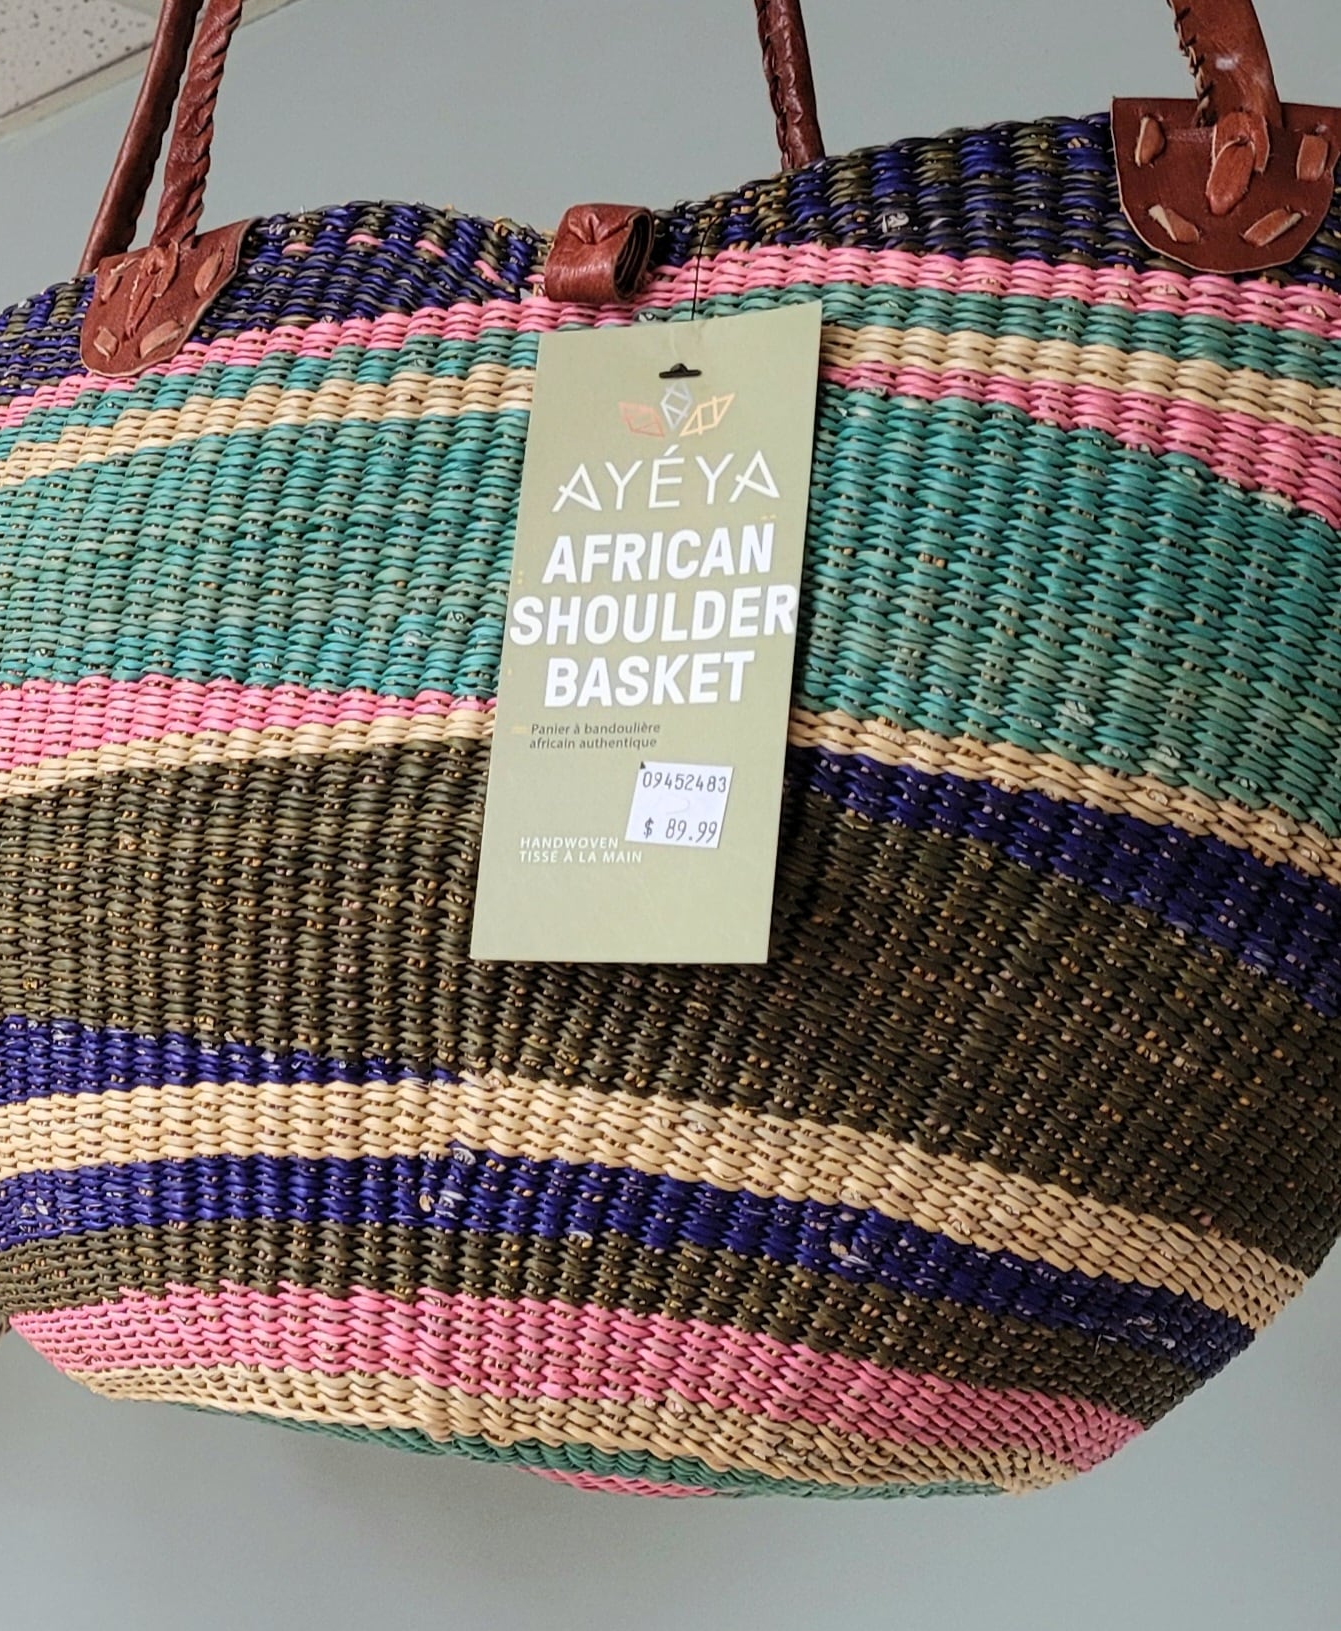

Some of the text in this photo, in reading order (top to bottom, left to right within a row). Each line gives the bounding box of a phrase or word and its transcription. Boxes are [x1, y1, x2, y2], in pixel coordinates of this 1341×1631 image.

[552, 444, 780, 513] AYÉYA
[542, 523, 775, 584] AFRICAN
[509, 584, 799, 646] SHOULDER
[544, 650, 755, 708] BASKET
[531, 721, 661, 735] Panier à bandoulière
[529, 736, 658, 750] africain authentique
[642, 771, 727, 793] 09452483
[519, 836, 619, 849] HANDWOVEN
[643, 817, 718, 844] $ 89.99
[578, 851, 597, 863] LA
[602, 851, 643, 863] MAIN
